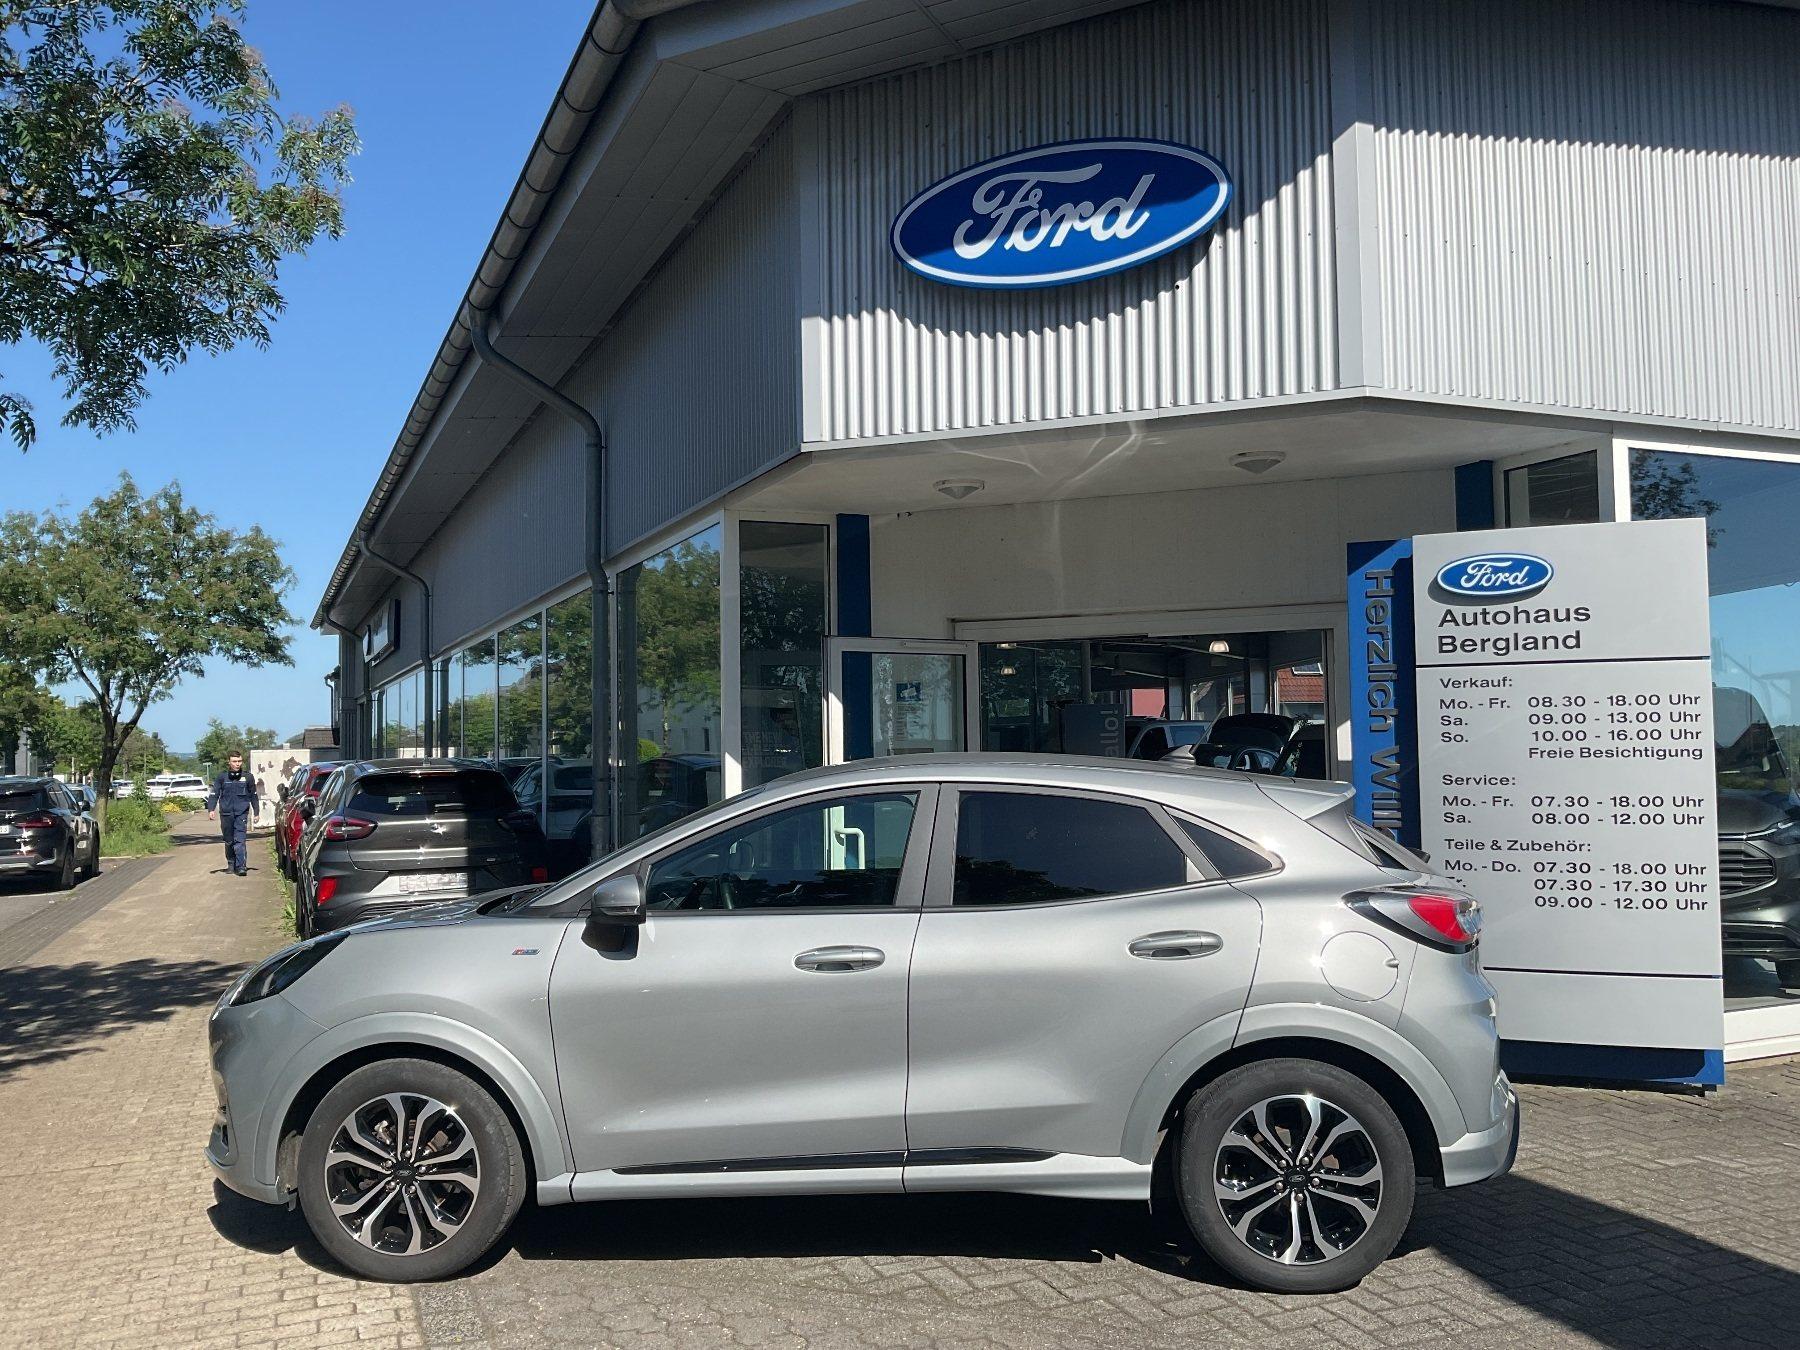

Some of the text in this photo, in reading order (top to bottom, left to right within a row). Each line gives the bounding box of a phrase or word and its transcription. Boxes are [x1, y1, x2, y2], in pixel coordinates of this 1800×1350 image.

[953, 163, 1156, 260] Ford
[1459, 560, 1530, 589] Ford
[1437, 604, 1592, 628] Autohaus
[1364, 568, 1398, 732] Herzlich
[1437, 629, 1581, 657] Bergland
[1439, 676, 1513, 689] Verkauf:
[1527, 695, 1586, 708] 08.30
[1606, 694, 1661, 707] 18.00
[1668, 693, 1701, 706] Uhr
[1440, 714, 1469, 727] Sa.
[1528, 712, 1587, 725] 09.00
[1607, 711, 1661, 724] 13.00
[1669, 711, 1701, 723] Uhr
[1100, 708, 1119, 756] allo!
[1440, 731, 1469, 743] So.
[1531, 729, 1587, 742] 10.00
[1607, 728, 1662, 741] 16.00
[1670, 728, 1702, 741] Uhr
[1528, 746, 1703, 761] Freie Besichtigung
[1441, 774, 1516, 786] Service:
[1530, 795, 1590, 808] 07.30
[1609, 795, 1664, 808] 18.00
[1672, 795, 1705, 808] Uhr
[1443, 811, 1472, 824] Sa.
[1531, 812, 1590, 825] 08.00
[1610, 813, 1665, 825] 12.00
[1672, 813, 1705, 825] Uhr
[1443, 838, 1591, 852] Teile & Zubehör:
[1533, 861, 1591, 874] 07.30
[1612, 862, 1667, 875] 18.00
[1674, 863, 1707, 876] Uhr
[1533, 878, 1593, 892] 07.30
[1612, 880, 1667, 893] 17.30
[1675, 881, 1708, 893] Uhr
[1534, 895, 1593, 909] 09.00
[1613, 897, 1668, 910] 12.00
[1676, 898, 1708, 911] Uhr
